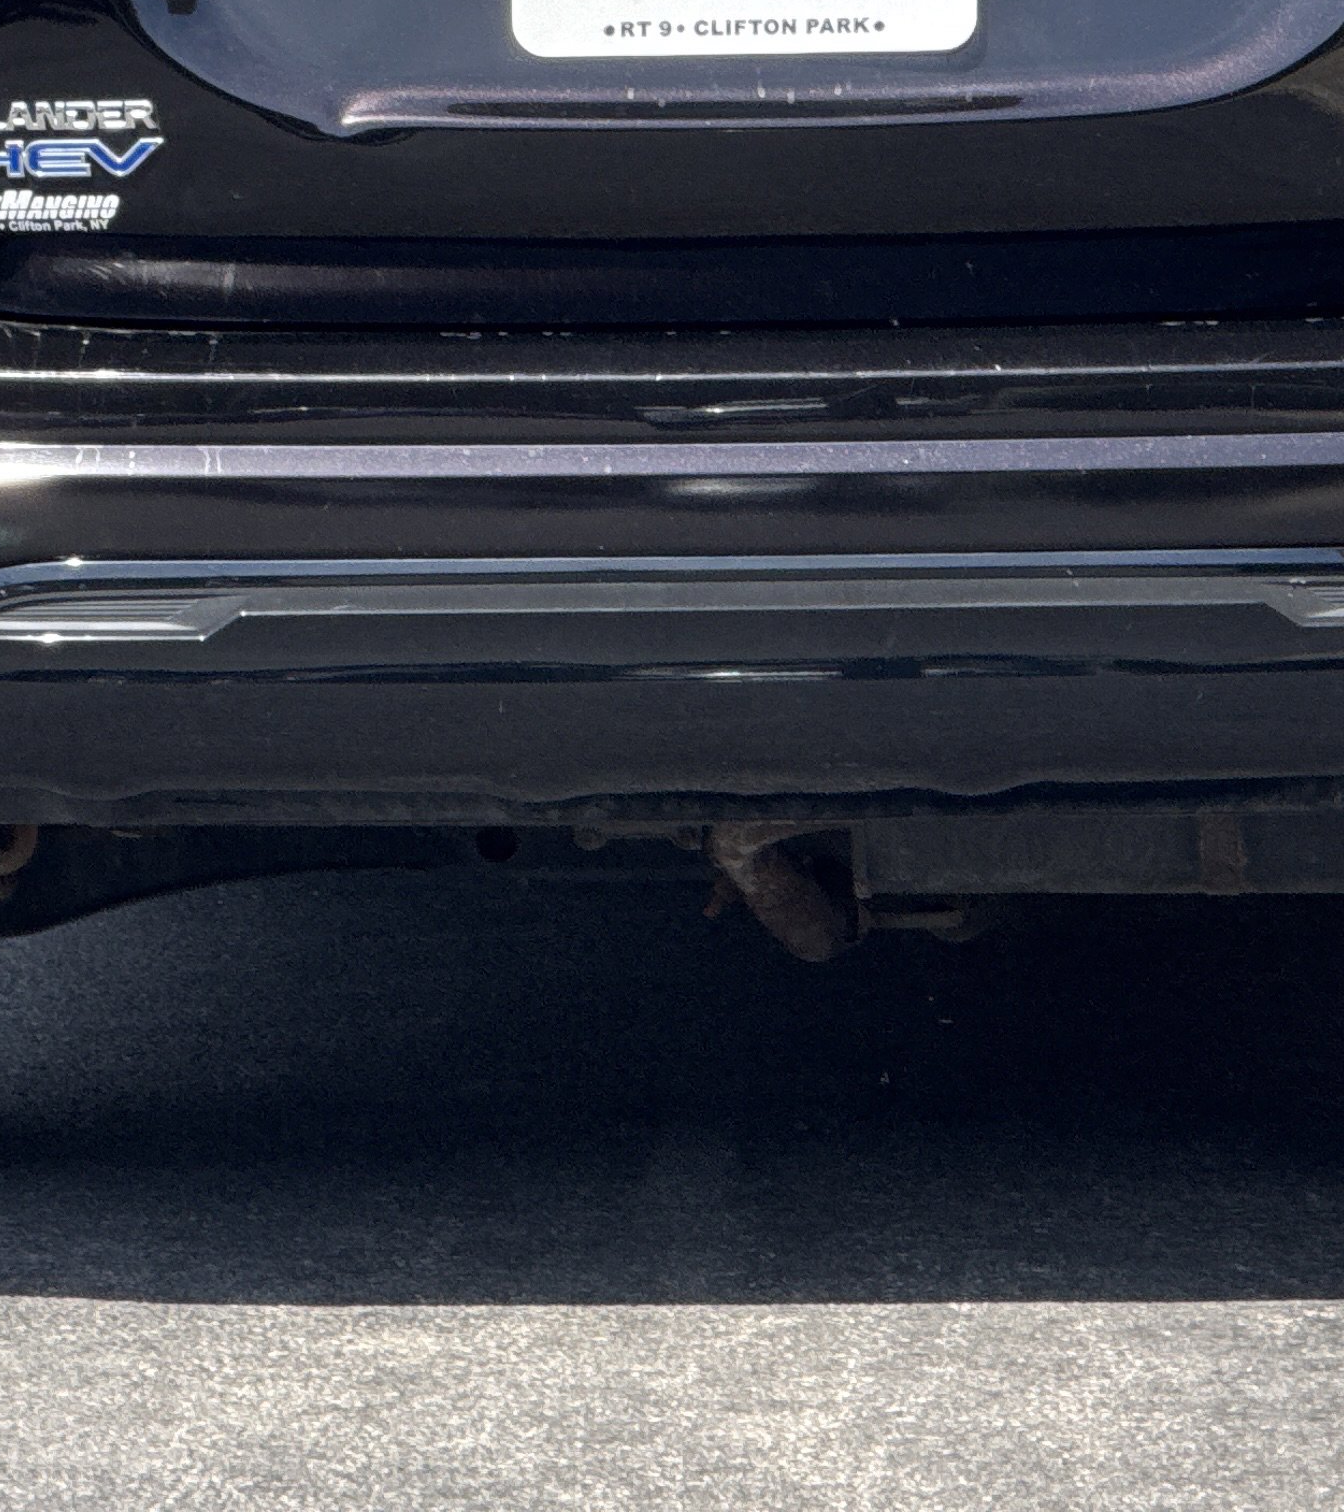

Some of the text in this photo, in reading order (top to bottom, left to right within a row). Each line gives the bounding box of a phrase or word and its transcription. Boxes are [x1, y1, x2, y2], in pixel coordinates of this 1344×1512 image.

[620, 21, 652, 38] RT
[694, 18, 798, 37] CLIFTON
[806, 16, 870, 35] PARK
[8, 220, 51, 232] Clifton
[90, 219, 109, 230] NY
